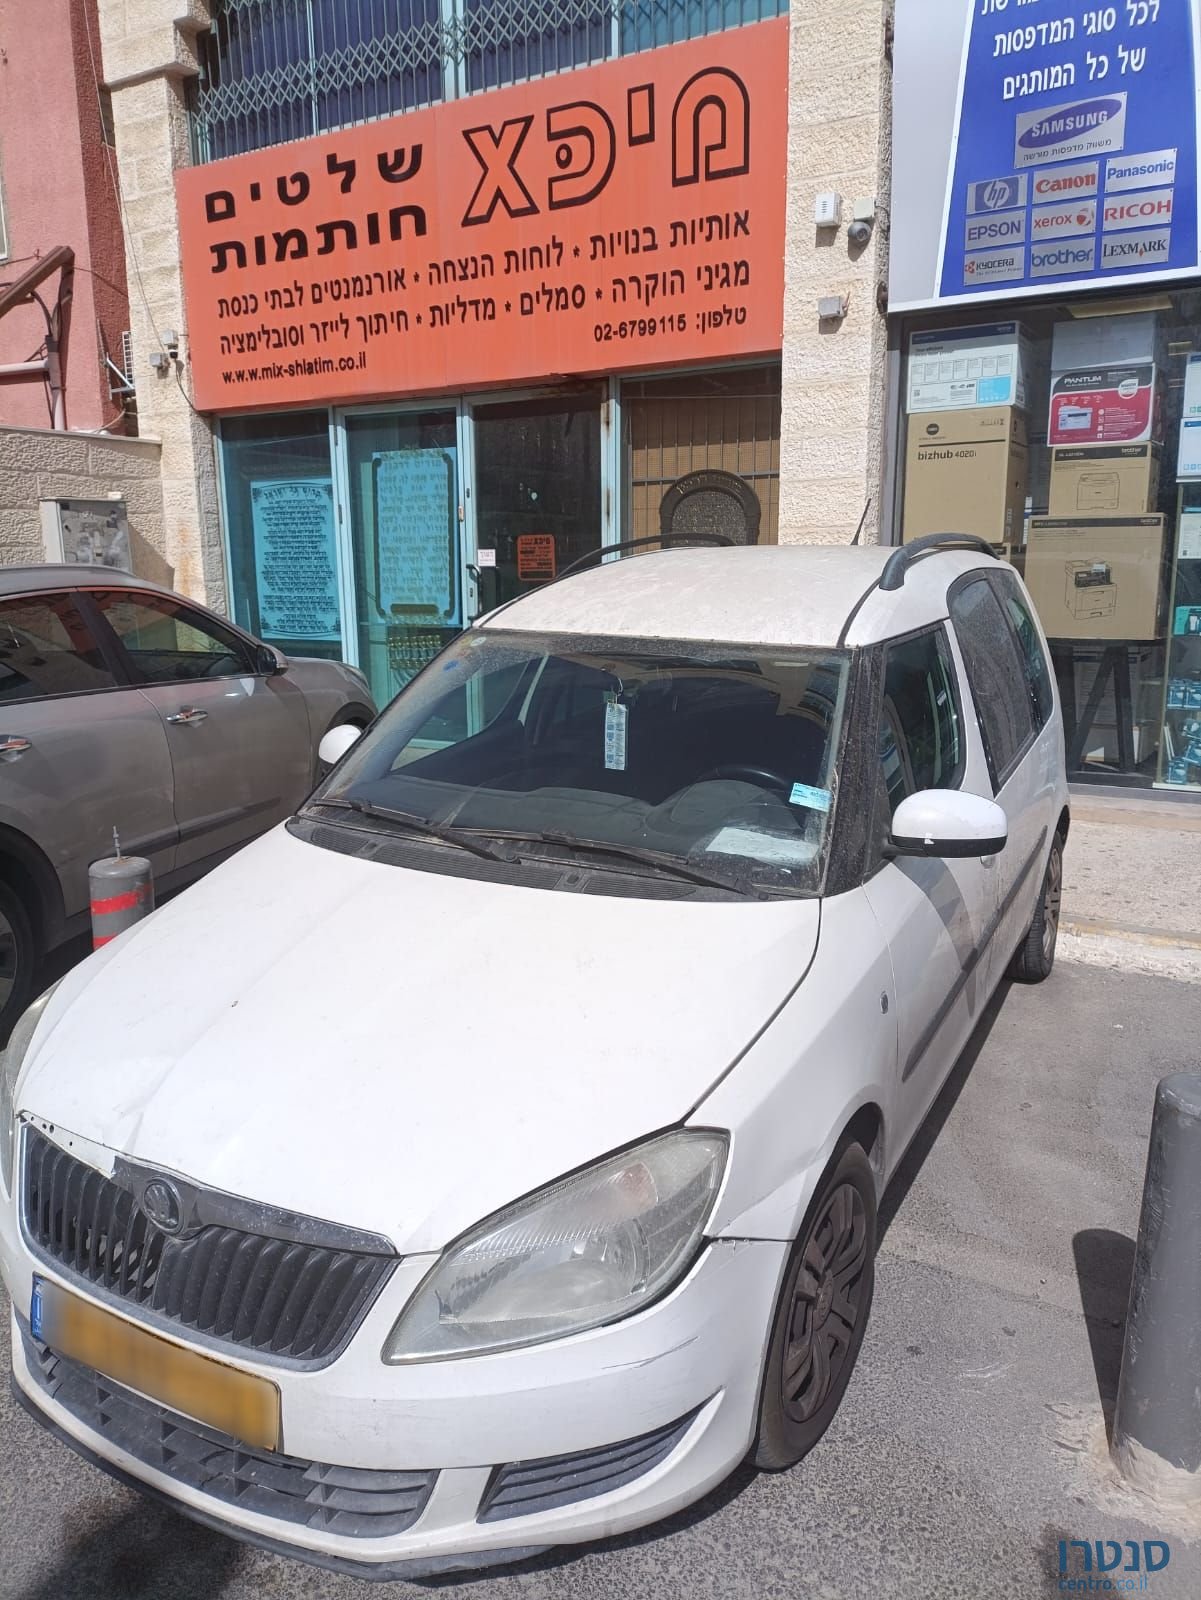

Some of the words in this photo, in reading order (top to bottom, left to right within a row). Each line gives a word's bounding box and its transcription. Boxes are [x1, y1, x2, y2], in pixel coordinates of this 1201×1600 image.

[1083, 7, 1117, 36] סוגי
[1126, 0, 1161, 27] לכל
[993, 17, 1075, 57] המדפסות
[1086, 51, 1109, 81] כל
[1117, 44, 1147, 75] של
[1003, 62, 1075, 100] המותגים
[1031, 110, 1108, 138] SAMSUNG
[1051, 144, 1084, 155] מדפסות
[1086, 139, 1112, 151] משווק
[204, 143, 423, 224] שלטים
[1035, 173, 1096, 194] Canon
[1107, 159, 1174, 180] Panasonic
[1033, 213, 1073, 230] xerox
[1104, 199, 1171, 222] RICOH
[209, 204, 427, 274] חותמות
[589, 226, 659, 261] בנויות
[669, 209, 751, 248] אותיות
[967, 221, 1022, 242] EPSON
[503, 234, 564, 275] לוחות
[976, 257, 1014, 270] KYOCERA
[1031, 248, 1094, 268] brother
[1103, 239, 1167, 257] LEXMARK
[428, 253, 495, 286] הנצחה
[696, 259, 751, 292] מגיני
[264, 279, 304, 311] לבתי
[310, 267, 407, 305] אורנמנטים
[519, 281, 586, 316] סמלים
[612, 269, 685, 307] הוקרה
[217, 293, 259, 319] כנסת
[428, 294, 496, 328] מדליות
[696, 303, 747, 335] טלפון:
[219, 323, 305, 355] וסובלימציה
[309, 312, 350, 343] לייזר
[355, 309, 409, 344] חיתוך
[593, 314, 687, 343] 02-6799115
[918, 449, 954, 461] bizhub
